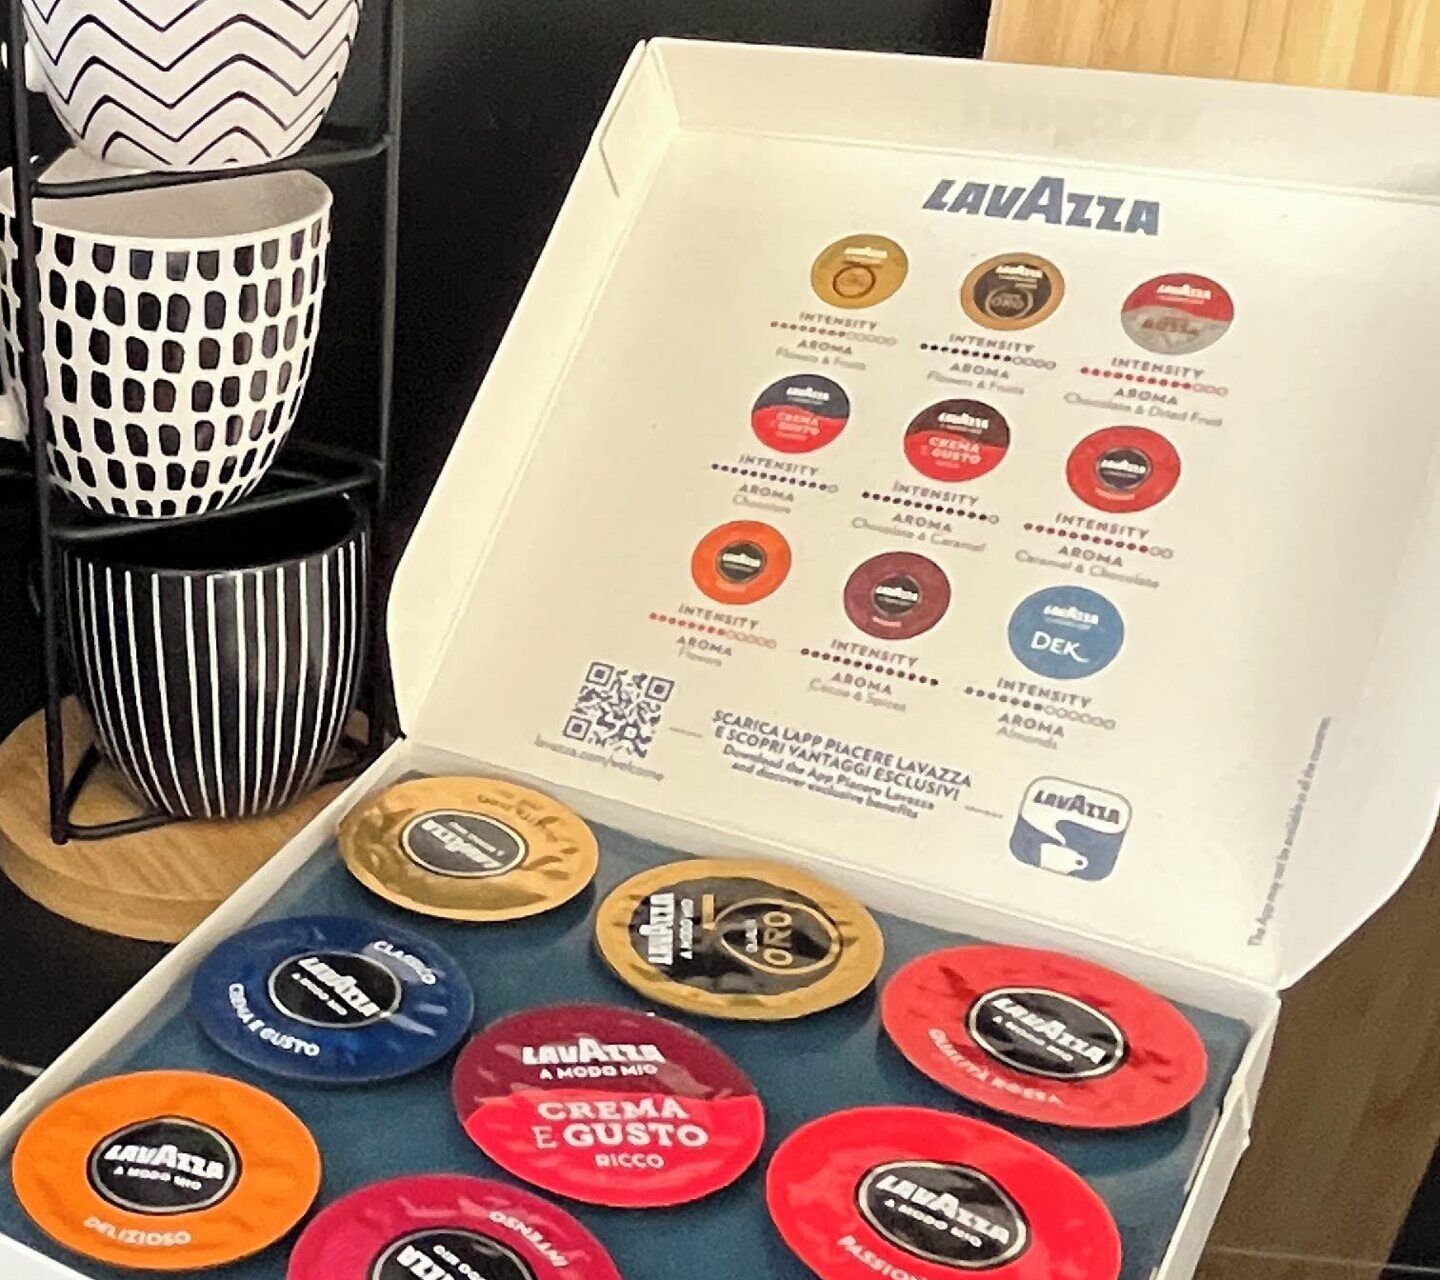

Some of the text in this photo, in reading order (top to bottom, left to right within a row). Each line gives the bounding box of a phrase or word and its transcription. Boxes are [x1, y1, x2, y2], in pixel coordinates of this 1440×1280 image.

[922, 176, 1160, 236] LAVAZZA
[799, 312, 878, 331] INTENSITY
[797, 339, 853, 355] AROMA
[949, 333, 1035, 353] INTENSITY
[950, 363, 1009, 379] AROMA
[1111, 357, 1205, 378] INTENSITY
[1113, 388, 1178, 405] AROMA
[738, 454, 819, 476] INTENSITY
[739, 484, 794, 502] AROMA
[892, 480, 979, 506] INTENSITY
[892, 513, 951, 532] AROMA
[1055, 513, 1150, 539] INTENSITY
[1058, 546, 1122, 566] AROMA
[678, 604, 759, 629] INTENSITY
[676, 636, 731, 656] AROMA
[831, 639, 919, 667] INTENSITY
[1031, 631, 1090, 663] DEK
[831, 672, 891, 695] AROMA
[997, 678, 1092, 708] INTENSITY
[998, 713, 1064, 737] AROMA
[713, 710, 779, 736] SCARICA
[824, 738, 894, 766] PIACERE
[896, 756, 971, 788] LAVAZZA
[715, 725, 960, 801] E SCOPRI VANTAGGI ESCLUSIVI
[1033, 790, 1120, 824] LAVAZZA
[420, 818, 503, 869] LAVAZZA
[638, 892, 676, 966] LAVAZZA
[762, 910, 794, 967] ORO
[373, 939, 437, 986] CLASSICO
[297, 956, 382, 1018] LAVAZZA
[248, 1019, 265, 1033] E
[259, 1027, 321, 1057] GUSTO
[991, 996, 1108, 1065] LAVAZZA
[521, 1036, 667, 1066] LAVAZZA
[539, 1063, 659, 1081] A MODO MIO
[537, 1096, 690, 1121] CREMA
[531, 1123, 710, 1151] E GUSTO
[103, 1144, 226, 1181] LAVAZZA
[594, 1152, 665, 1170] RICCO
[113, 1165, 203, 1191] A MODO MIO
[875, 1175, 1010, 1246] LAVAZZA
[884, 1197, 983, 1249] A MODO MIO
[82, 1215, 193, 1247] DELIZIOSO
[488, 1210, 570, 1268] INTENSO
[432, 1244, 461, 1266] MIO
